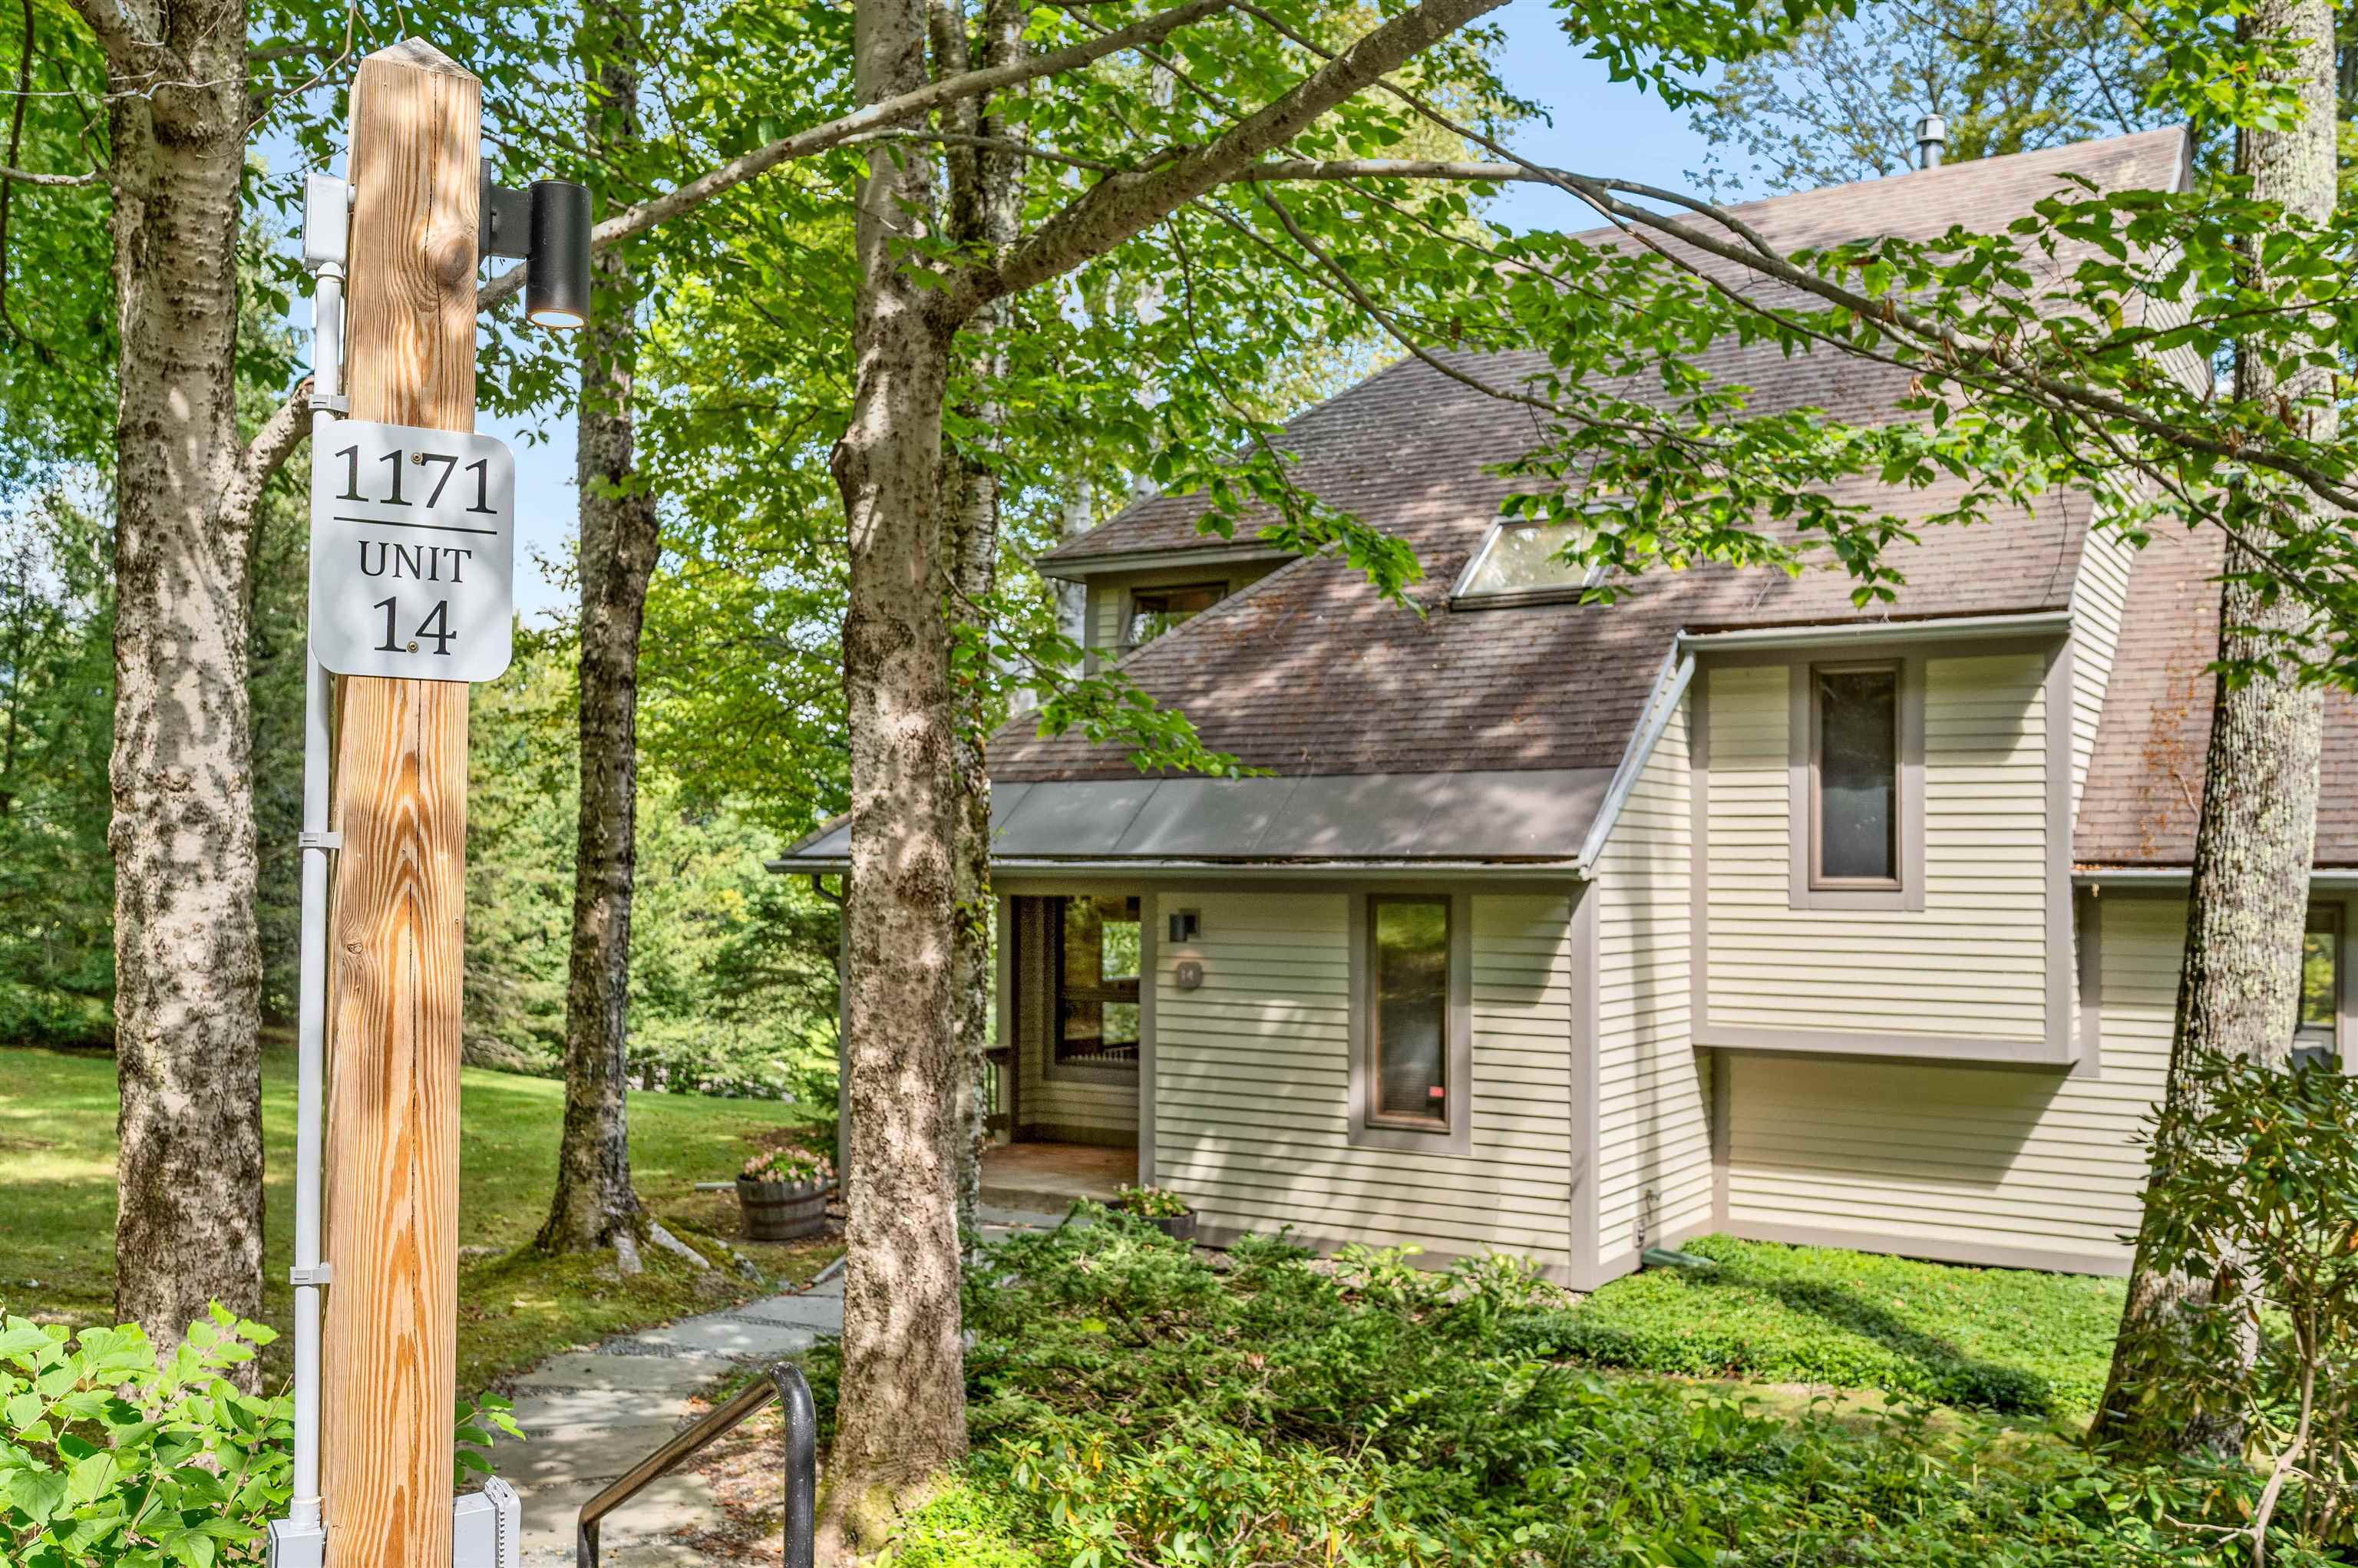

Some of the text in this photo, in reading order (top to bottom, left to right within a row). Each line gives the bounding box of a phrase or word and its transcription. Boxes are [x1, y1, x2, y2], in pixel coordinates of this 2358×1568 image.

[335, 444, 497, 514] 1171
[358, 540, 472, 583] UNIT
[373, 596, 457, 655] 14
